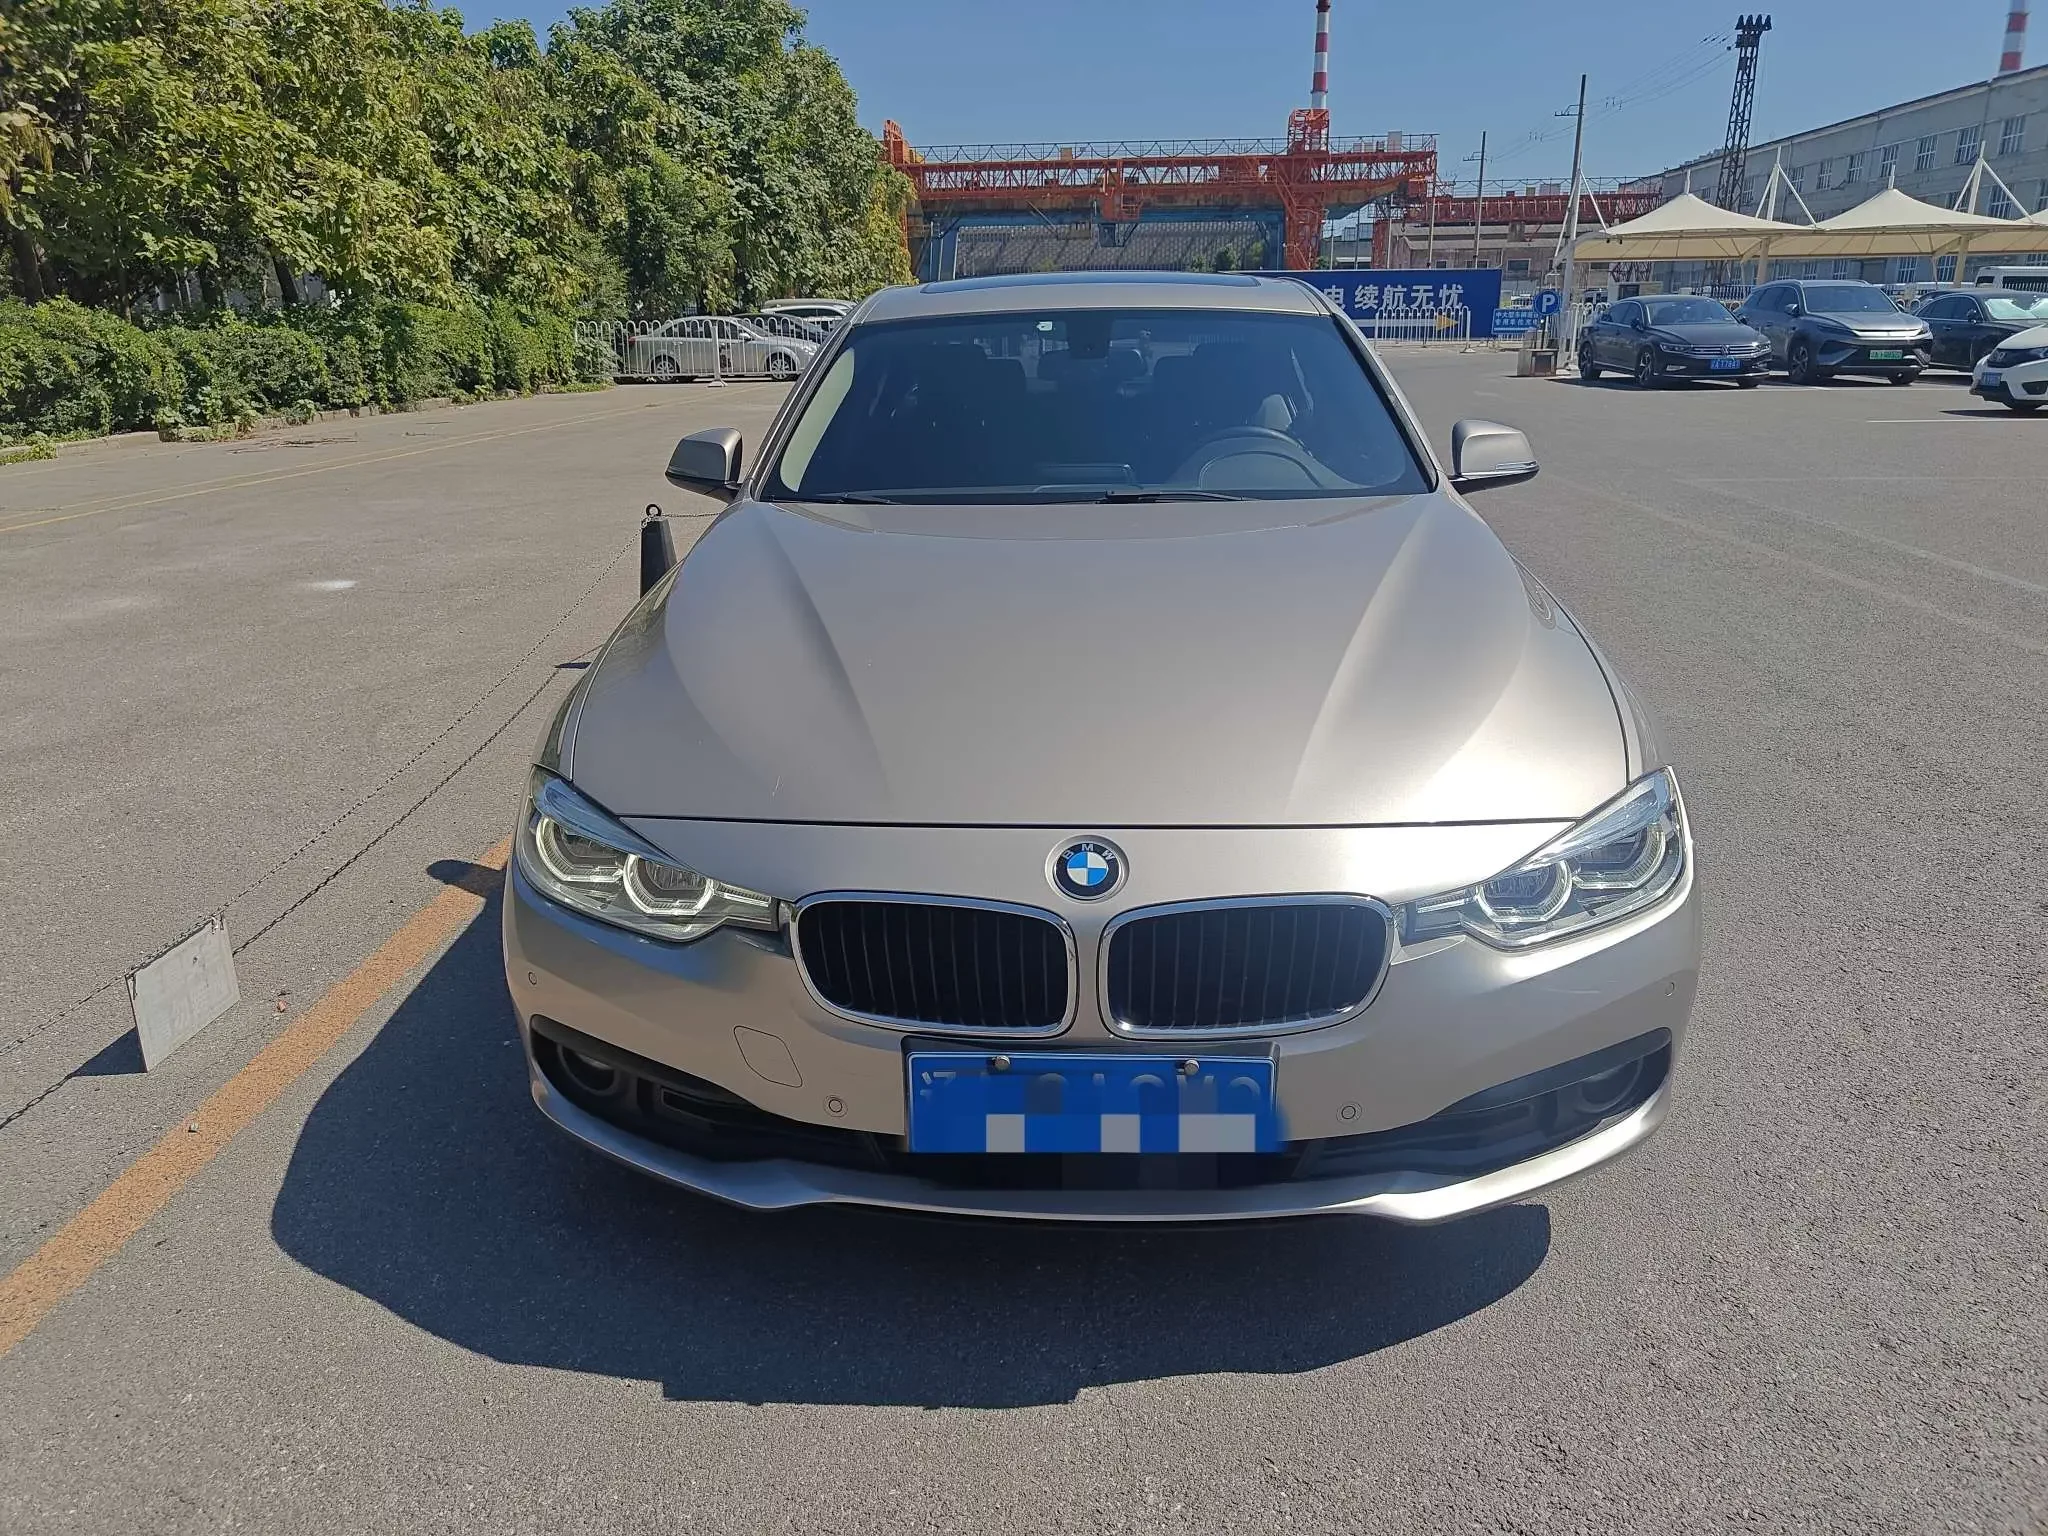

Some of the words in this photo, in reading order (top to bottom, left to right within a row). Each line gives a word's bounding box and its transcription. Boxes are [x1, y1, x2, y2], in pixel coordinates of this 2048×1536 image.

[1354, 283, 1464, 311] 续航无忧
[1541, 294, 1556, 313] P
[1061, 843, 1116, 861] BMW
